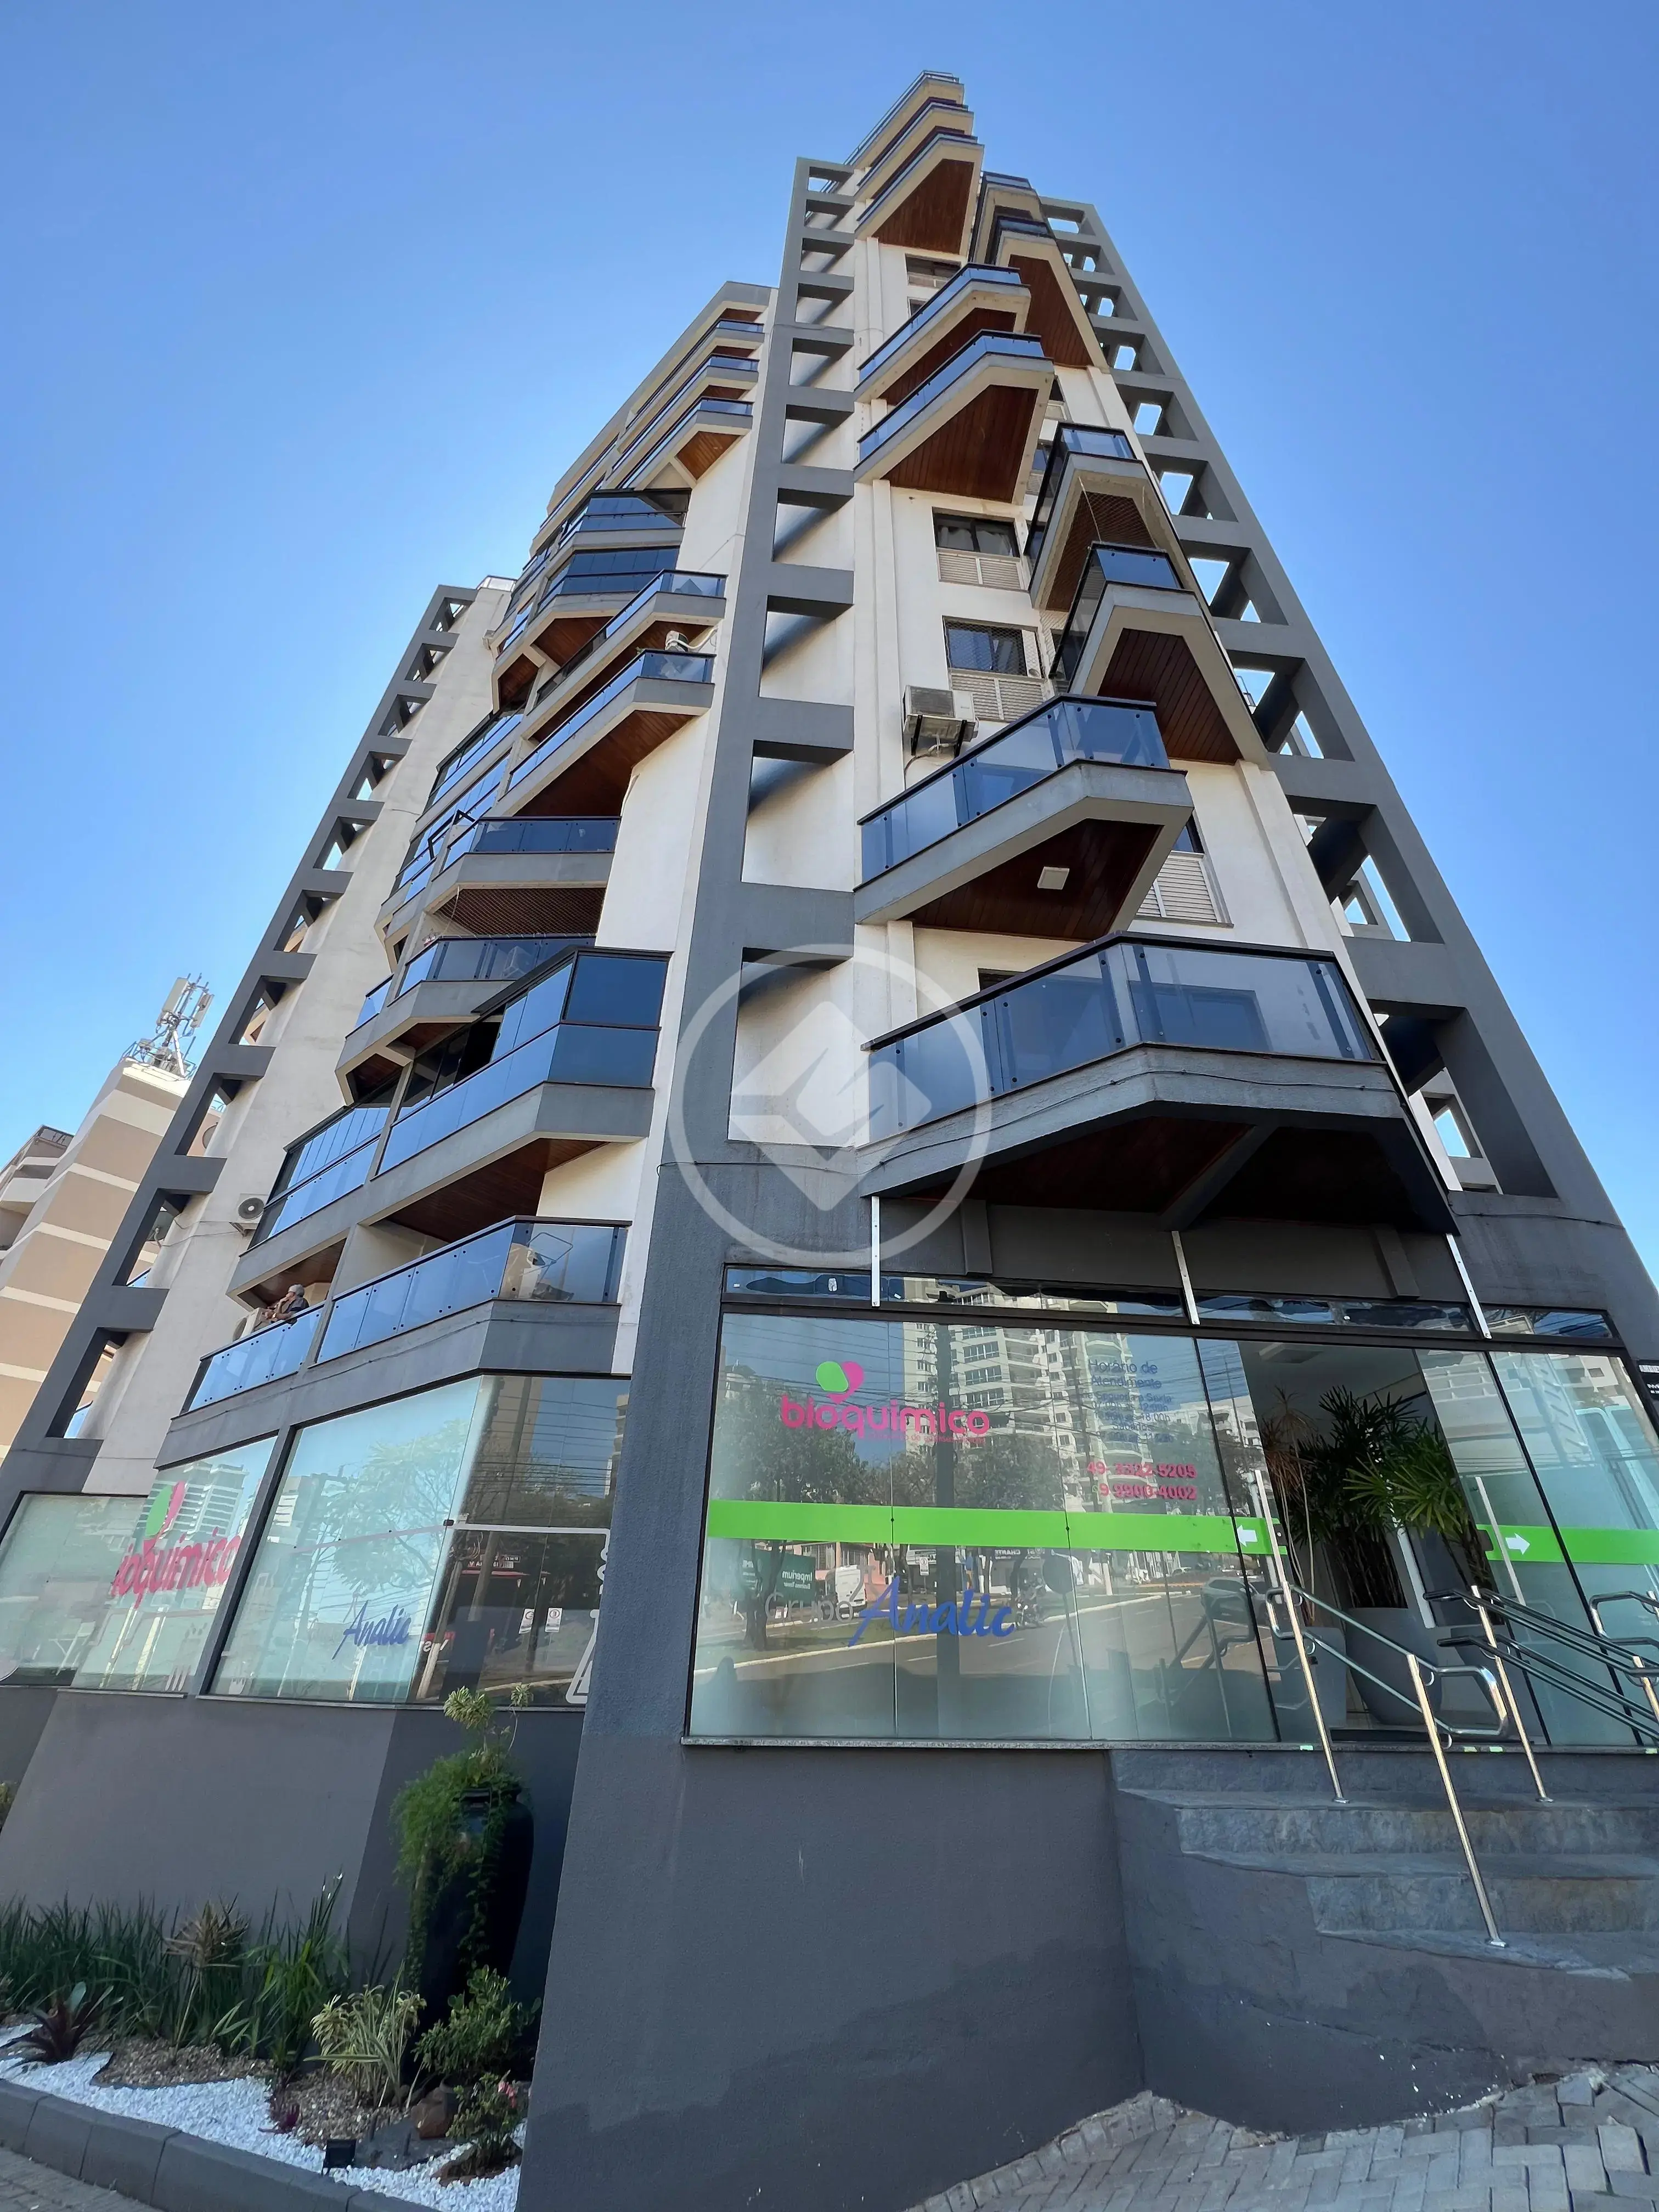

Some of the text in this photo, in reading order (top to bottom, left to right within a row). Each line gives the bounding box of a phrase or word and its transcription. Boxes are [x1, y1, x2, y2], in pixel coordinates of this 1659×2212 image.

[1141, 1362, 1158, 1374] de
[332, 1600, 411, 1660] Analic
[765, 1576, 1015, 1647] Grupo Analic
